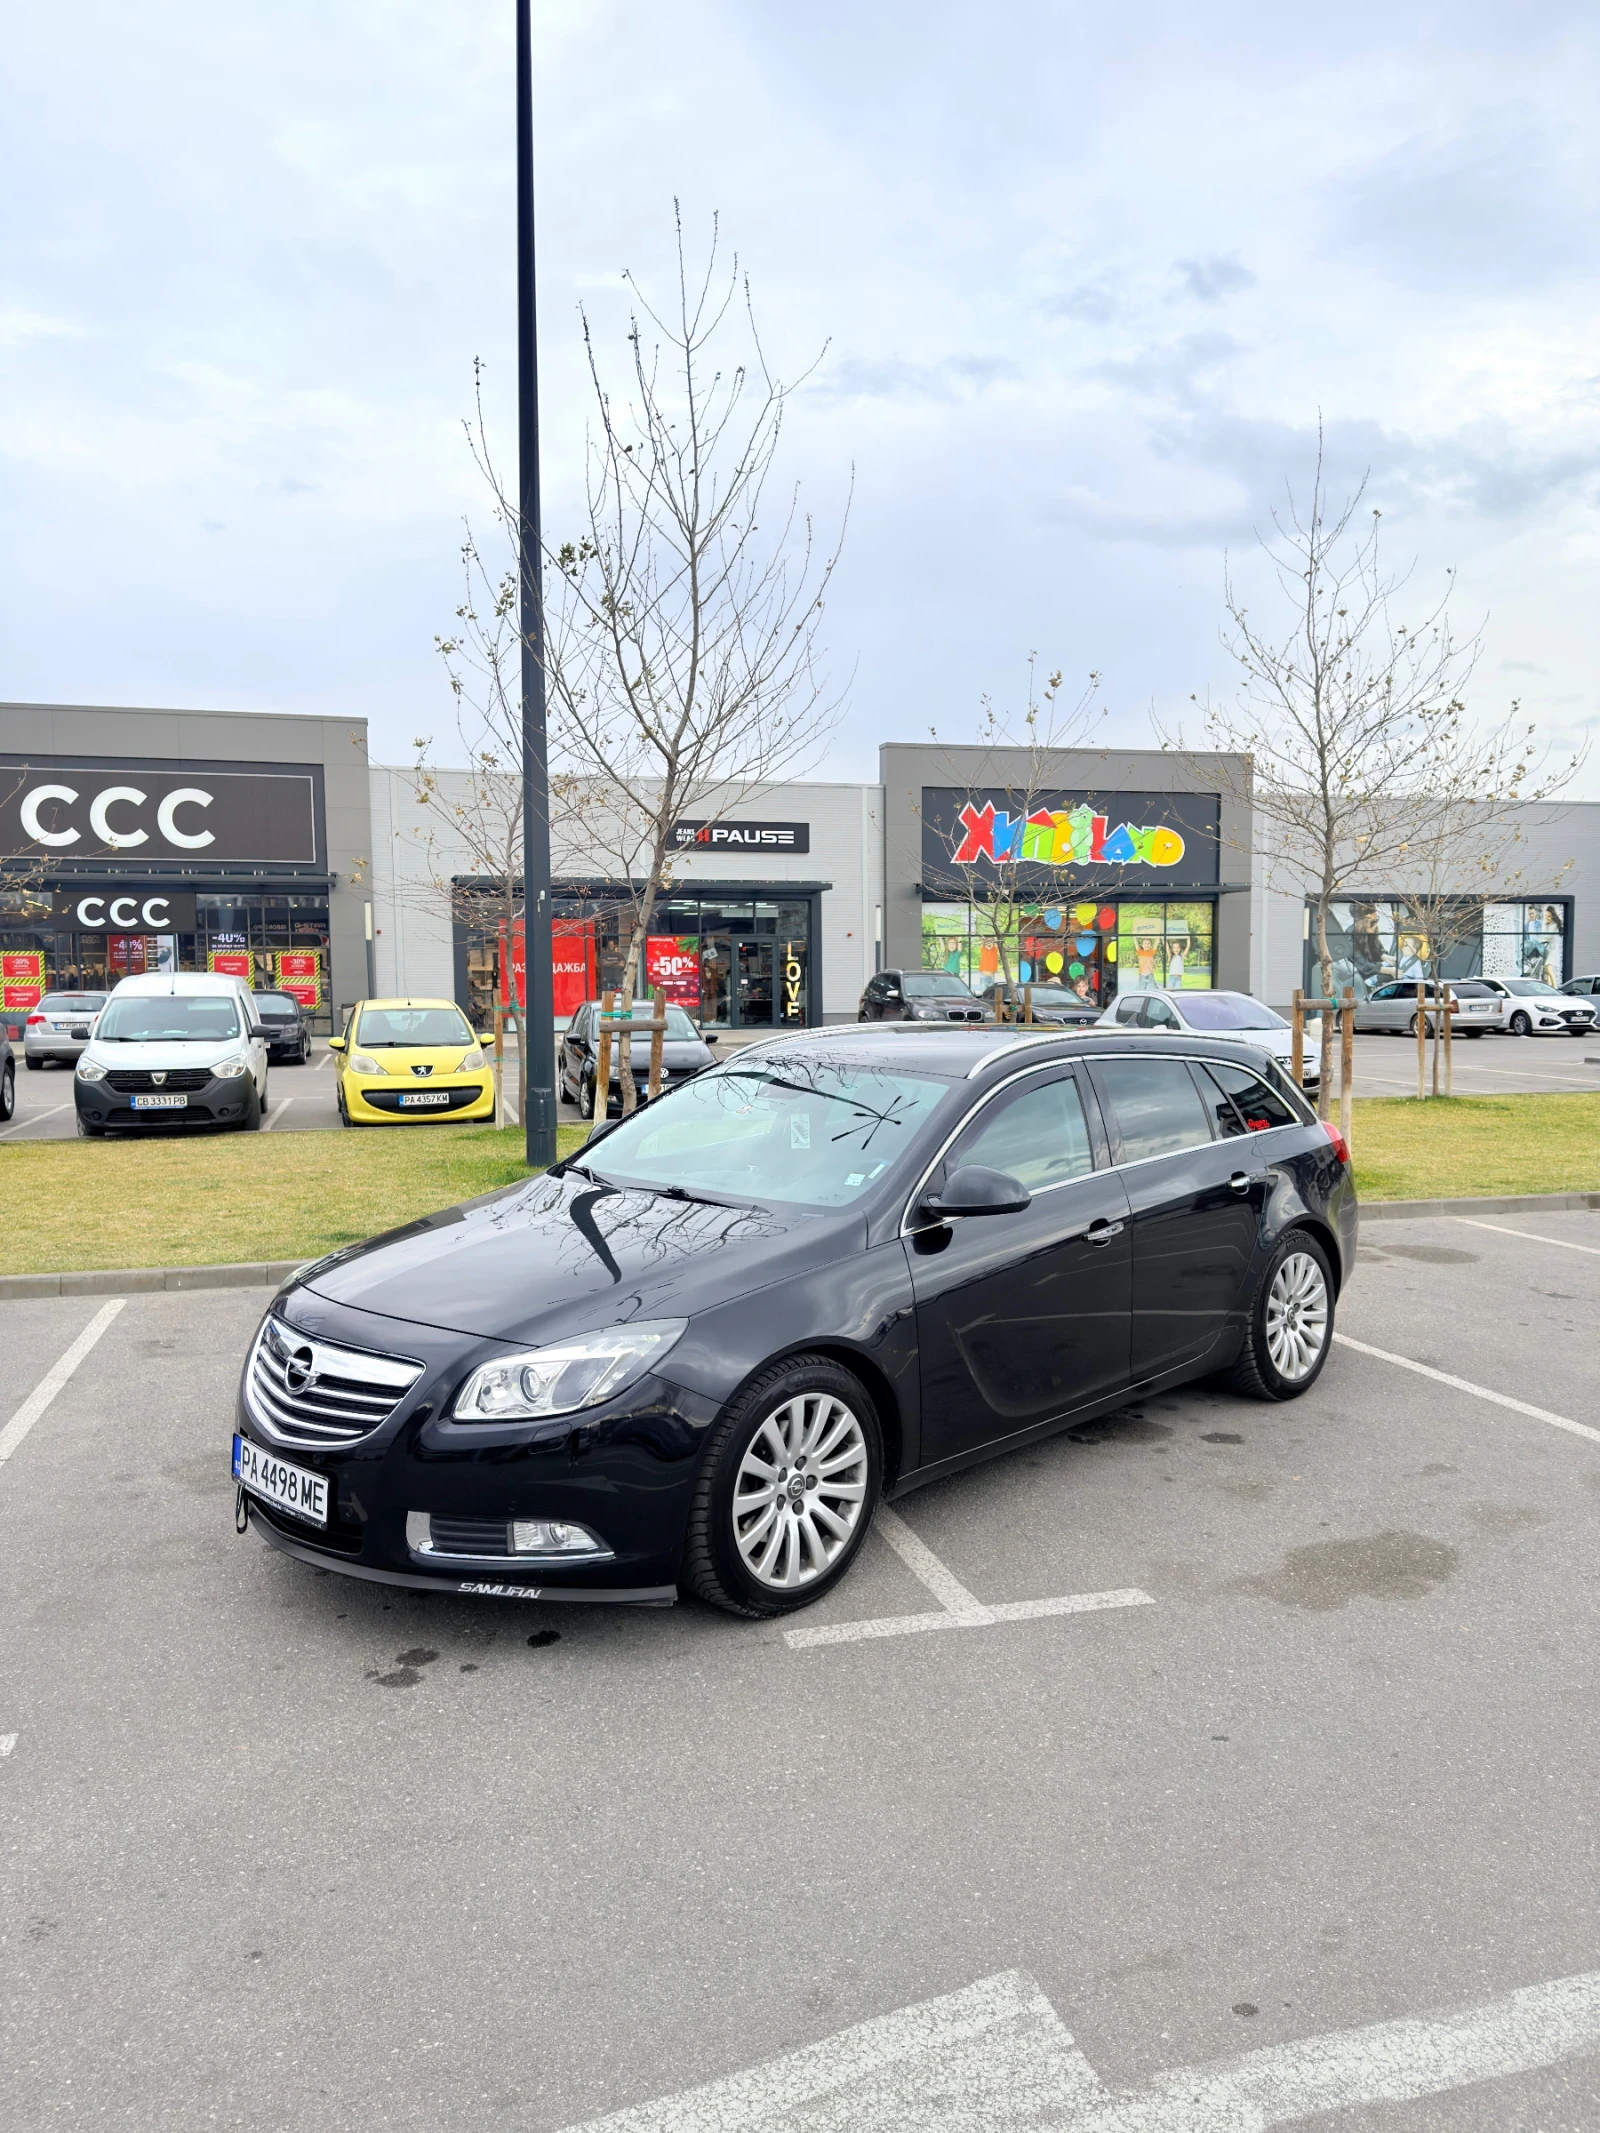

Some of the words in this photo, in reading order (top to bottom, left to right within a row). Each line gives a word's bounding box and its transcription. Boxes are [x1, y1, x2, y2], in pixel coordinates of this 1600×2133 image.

[20, 784, 216, 849] CCC
[712, 829, 795, 844] PAUSE
[77, 897, 171, 927] CCC
[212, 933, 246, 943] -40%
[137, 1097, 149, 1106] CB
[150, 1097, 172, 1105] 3331
[173, 1096, 186, 1105] PB
[404, 1096, 416, 1104] PA
[416, 1095, 436, 1103] 4357
[242, 1445, 258, 1482] PA
[261, 1459, 298, 1502] 4498
[301, 1476, 324, 1515] ME
[457, 1582, 542, 1599] SAMURAI
